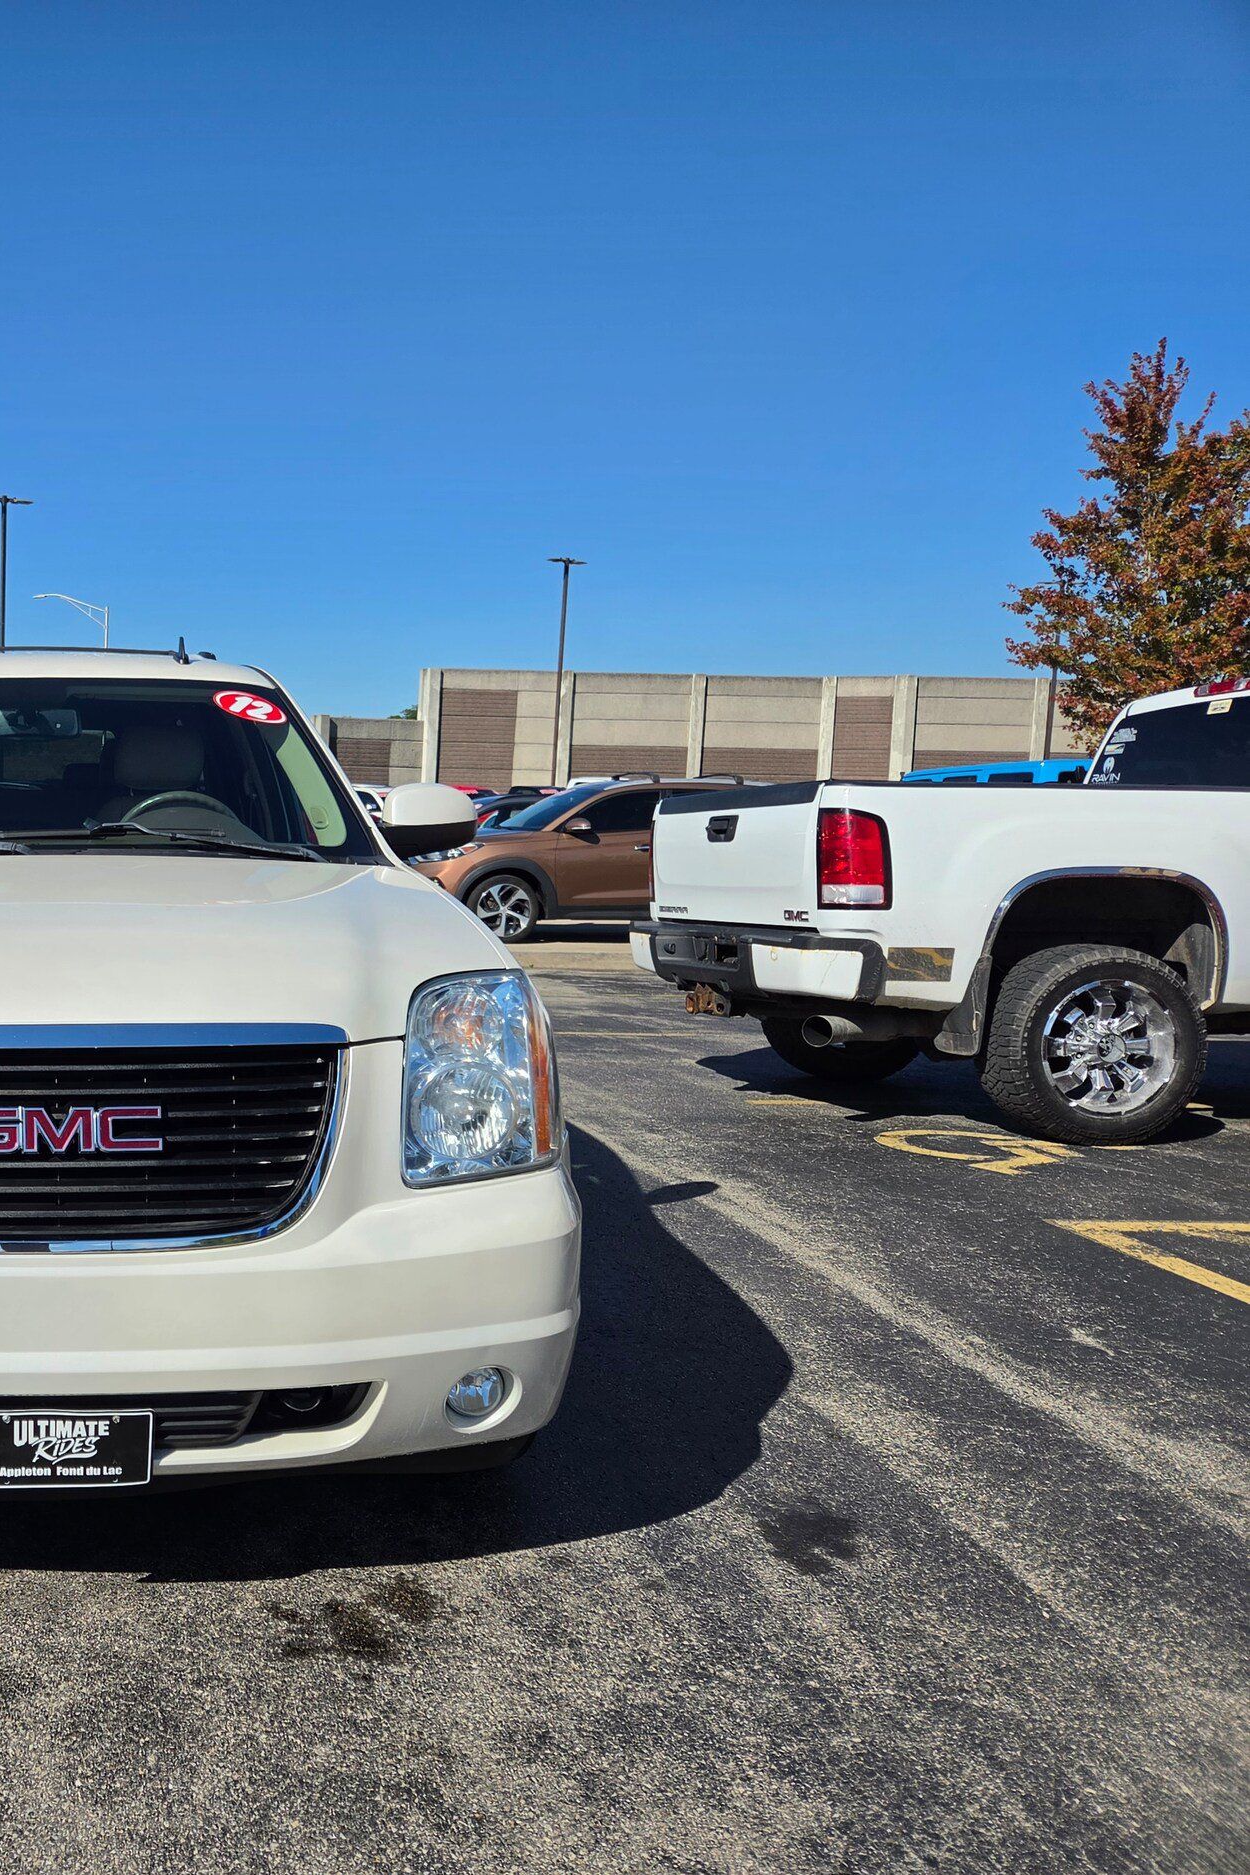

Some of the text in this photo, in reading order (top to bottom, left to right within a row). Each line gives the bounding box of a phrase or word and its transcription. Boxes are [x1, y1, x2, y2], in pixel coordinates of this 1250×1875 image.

[228, 696, 274, 720] 12
[1091, 773, 1121, 782] RAVIN
[783, 910, 810, 922] GMC
[13, 1419, 110, 1447] ULTIMATE
[0, 1465, 123, 1477] Appleton Fond du Lac
